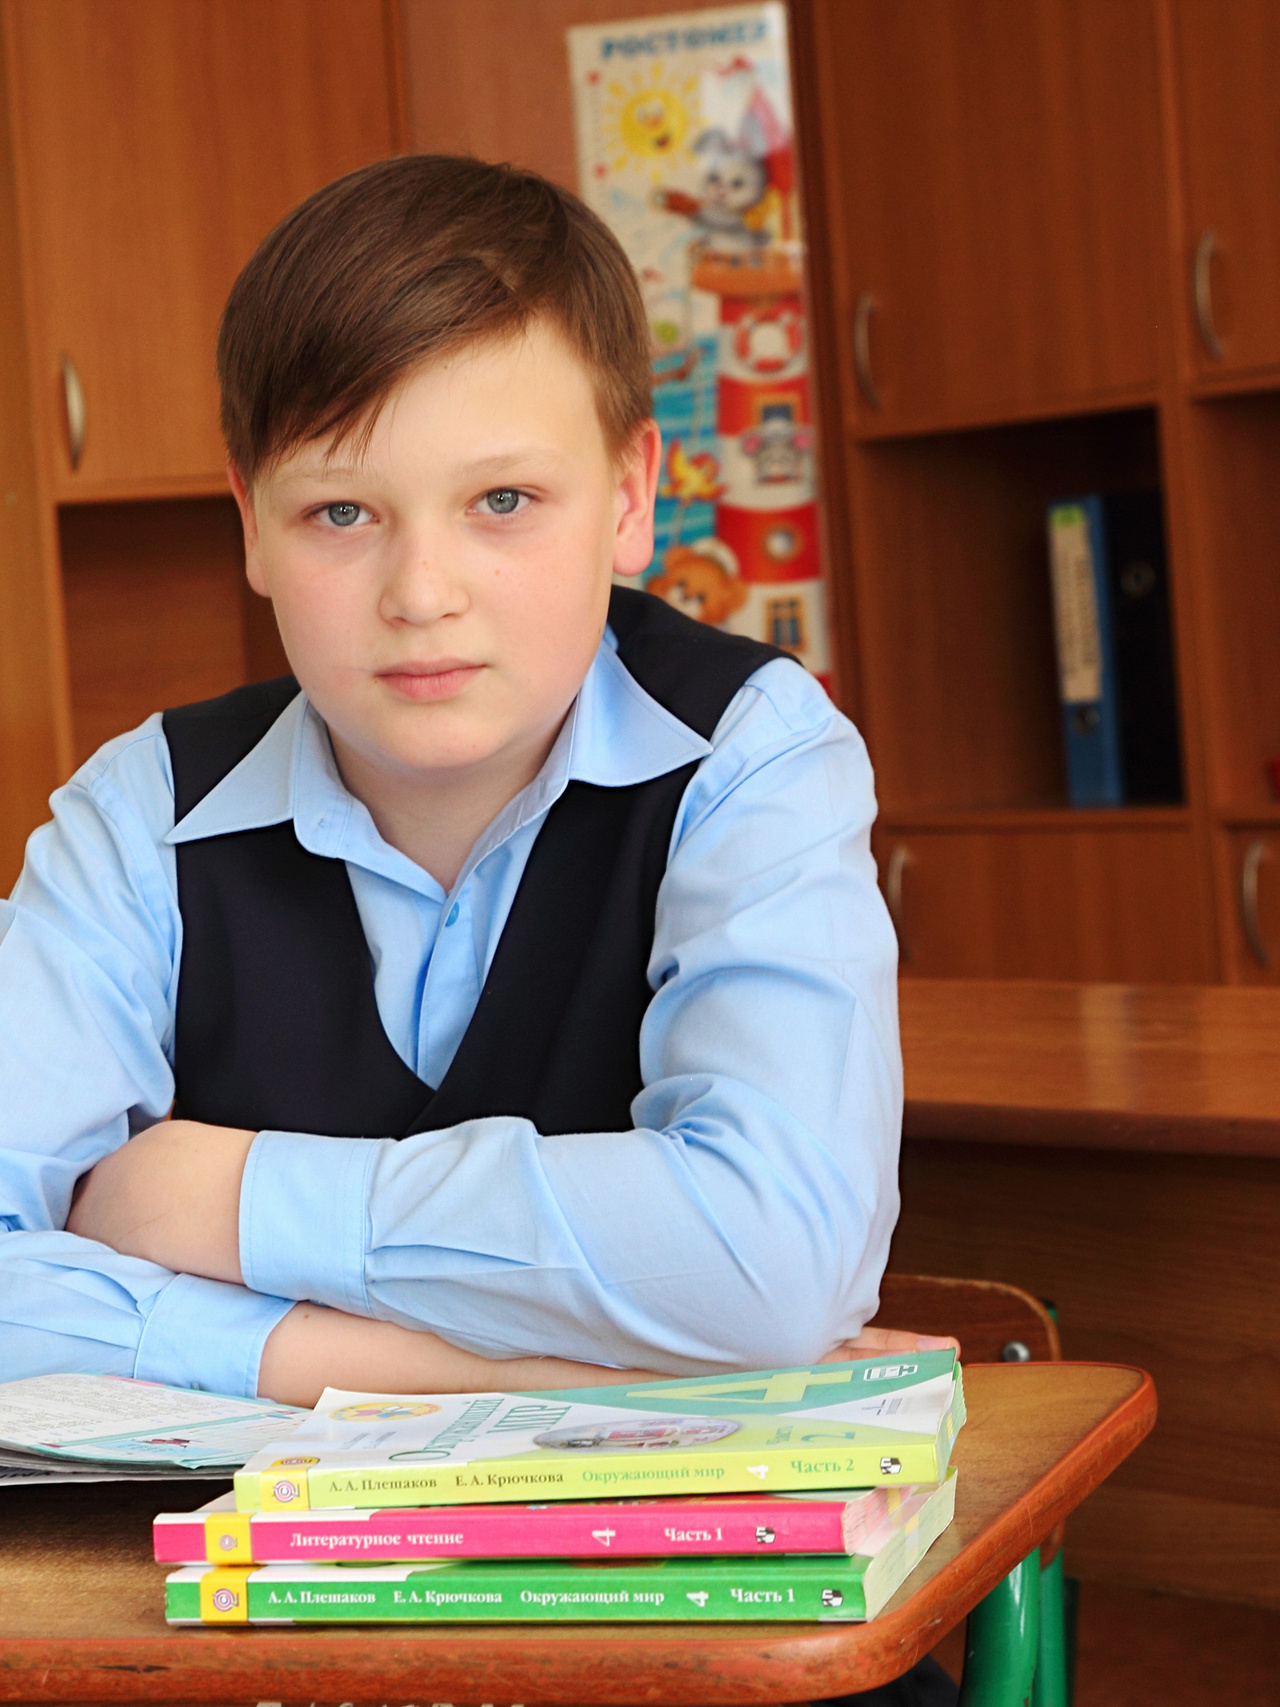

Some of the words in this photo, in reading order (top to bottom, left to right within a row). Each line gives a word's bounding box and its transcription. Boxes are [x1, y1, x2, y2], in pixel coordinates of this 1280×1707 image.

[362, 1478, 437, 1490] Плешаков
[456, 1476, 468, 1486] Е.
[471, 1476, 484, 1486] А.
[488, 1471, 564, 1487] Крючкова
[582, 1469, 690, 1483] Окружающий
[694, 1466, 725, 1480] мир
[791, 1460, 838, 1473] Часть
[845, 1459, 854, 1471] 2
[290, 1534, 401, 1548] Литературное
[407, 1534, 463, 1544] чтение
[664, 1528, 712, 1542] Часть
[716, 1528, 723, 1540] 1
[268, 1593, 282, 1603] А.
[284, 1593, 298, 1603] А.
[300, 1592, 376, 1604] Плешаков
[394, 1592, 406, 1602] Е.
[409, 1592, 422, 1602] А.
[426, 1591, 502, 1604] Крючкова
[520, 1590, 629, 1604] Окружающий
[633, 1591, 665, 1605] мир
[730, 1588, 783, 1603] Часть
[787, 1589, 795, 1602] 1
